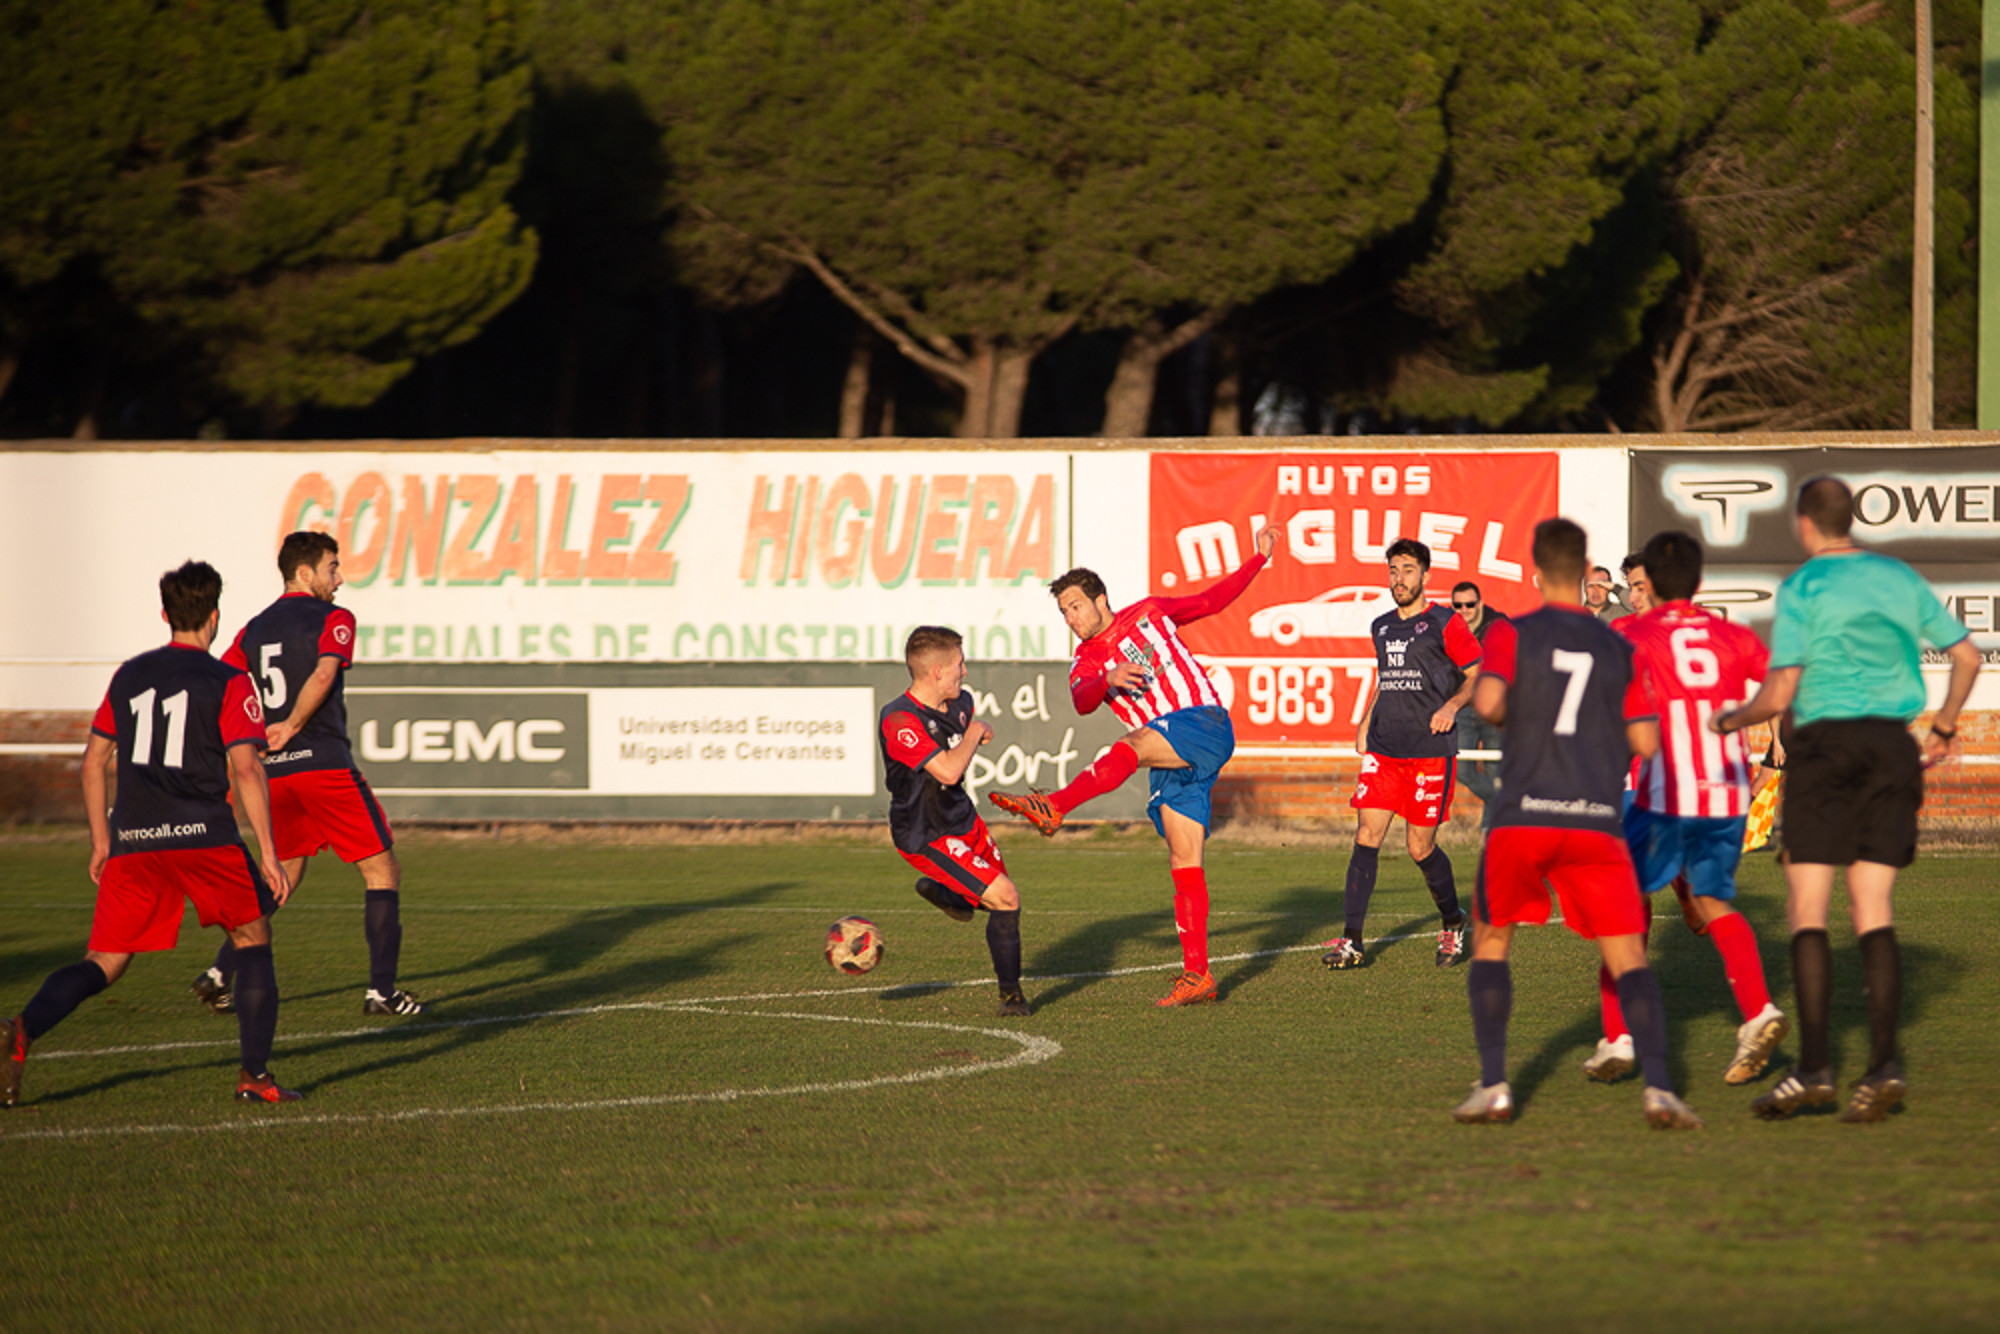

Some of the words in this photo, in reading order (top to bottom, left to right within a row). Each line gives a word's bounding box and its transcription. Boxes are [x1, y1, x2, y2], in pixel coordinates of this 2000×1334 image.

[1278, 465, 1431, 495] AUTOS
[1853, 484, 2000, 526] OWE
[277, 471, 694, 587] GONZALEZ
[739, 472, 1055, 589] HIGUERA
[594, 625, 649, 657] DE
[673, 608, 1046, 657] CONSTRUIÓN
[260, 642, 288, 708] 5
[1387, 653, 1405, 667] NB
[1670, 627, 1720, 688] 6
[1011, 674, 1050, 722] el
[1247, 665, 1334, 725] 983
[1346, 666, 1380, 725] 7
[1552, 648, 1594, 736] 7
[129, 687, 189, 769] 11
[360, 719, 565, 762] UEMC
[619, 716, 749, 735] Universidad
[756, 716, 846, 738] Europea
[619, 743, 692, 765] Miguel
[700, 743, 727, 761] de
[735, 742, 846, 761] Cervantes
[117, 822, 207, 842] berrocall.com
